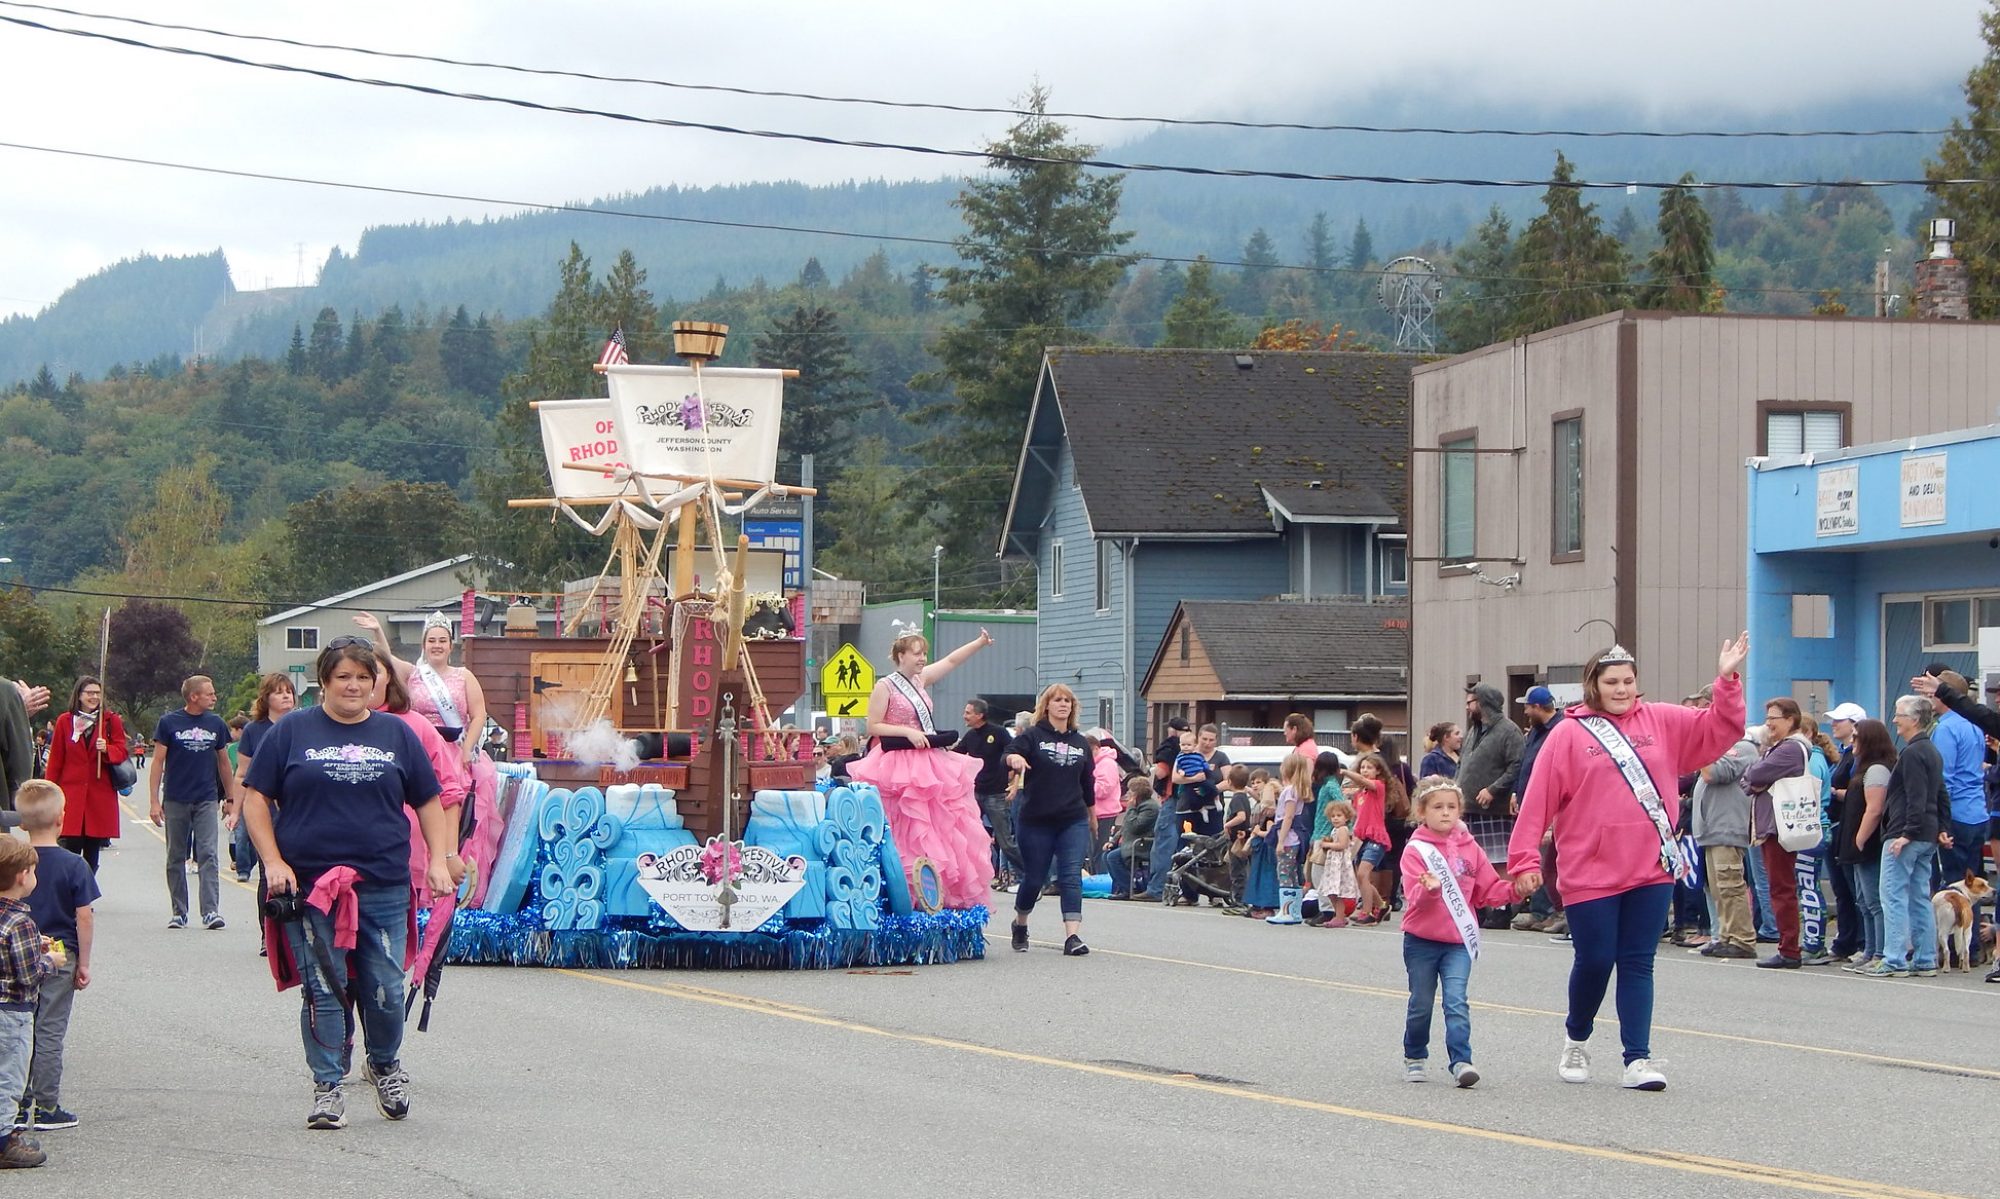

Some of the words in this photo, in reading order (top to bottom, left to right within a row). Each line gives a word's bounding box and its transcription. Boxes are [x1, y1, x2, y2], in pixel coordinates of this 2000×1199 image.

[642, 402, 681, 422] RHODY
[709, 403, 748, 425] FESTIVAL
[595, 420, 614, 434] OF
[569, 439, 618, 462] RHOD
[1909, 485, 1920, 497] AND
[1922, 482, 1937, 496] DELI
[750, 507, 769, 515] Auto
[769, 507, 799, 515] Service
[784, 572, 792, 585] 0
[692, 618, 714, 728] RHOD
[656, 848, 702, 875] RHODY
[744, 848, 791, 877] FESTIVAL
[663, 893, 692, 902] PORT
[696, 894, 760, 904] TOWEND,
[762, 895, 781, 903] WA.
[1440, 869, 1466, 918] PRINCESS
